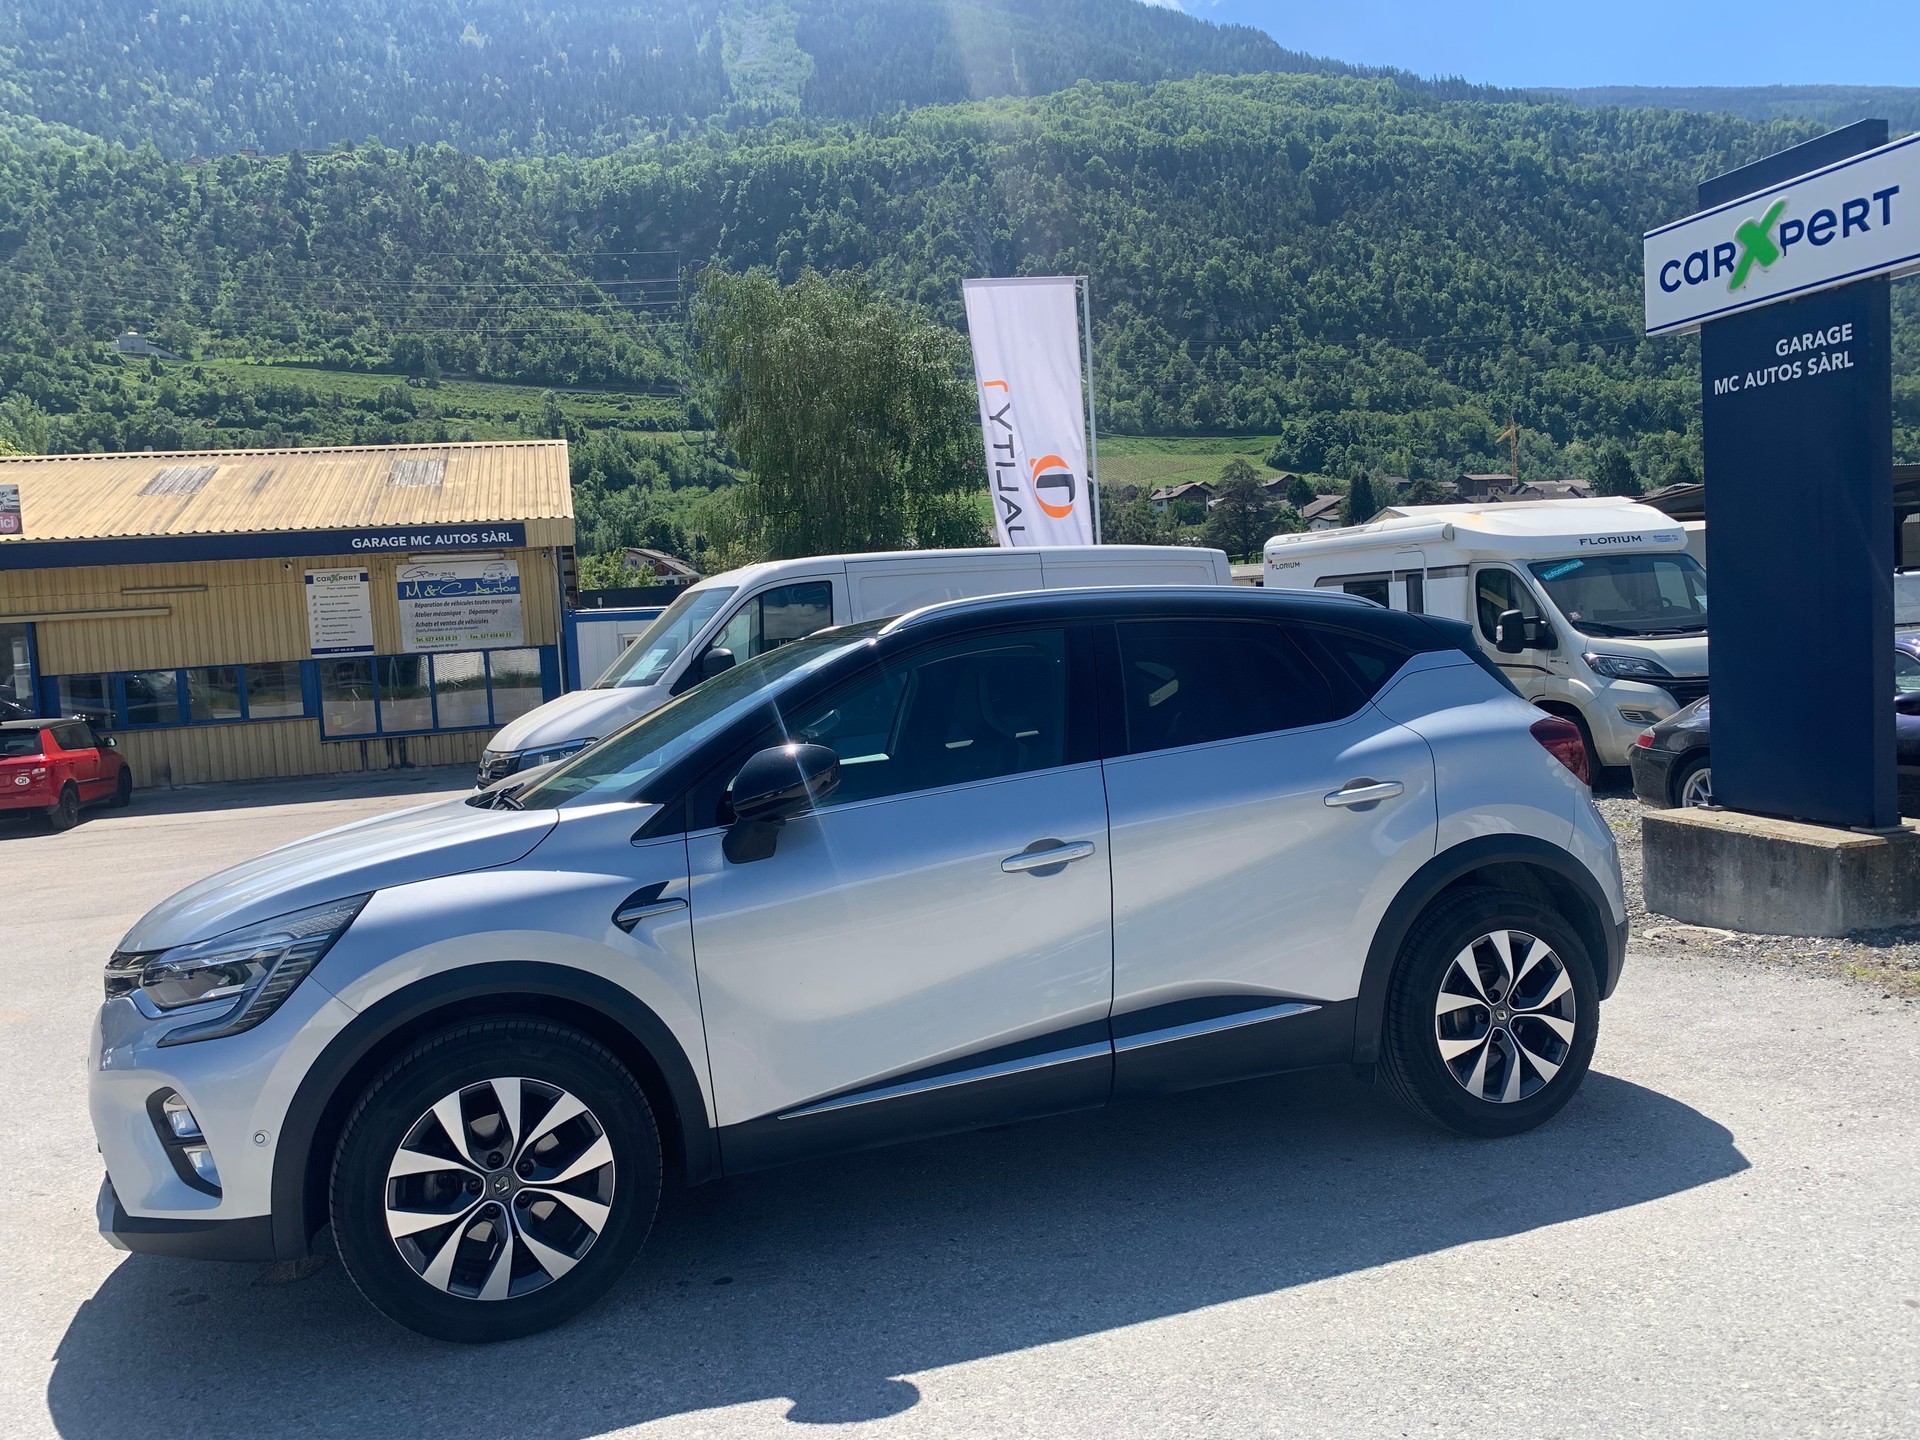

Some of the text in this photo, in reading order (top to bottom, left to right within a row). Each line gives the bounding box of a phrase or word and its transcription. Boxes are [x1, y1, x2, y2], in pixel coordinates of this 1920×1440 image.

[1775, 323, 1854, 356] GARAGE
[1714, 351, 1855, 396] MC AUTOS SÀRL
[351, 529, 514, 549] GARAGE MC AUTOS SÀRL
[1579, 535, 1643, 546] FLORIUM
[1271, 562, 1301, 570] FLORIUM
[1544, 560, 1584, 579] Automatique
[406, 580, 517, 598] M & C Autos
[414, 602, 443, 610] Réparation
[491, 598, 513, 606] marques
[433, 610, 462, 618] mécanique
[468, 608, 499, 616] Dépannage
